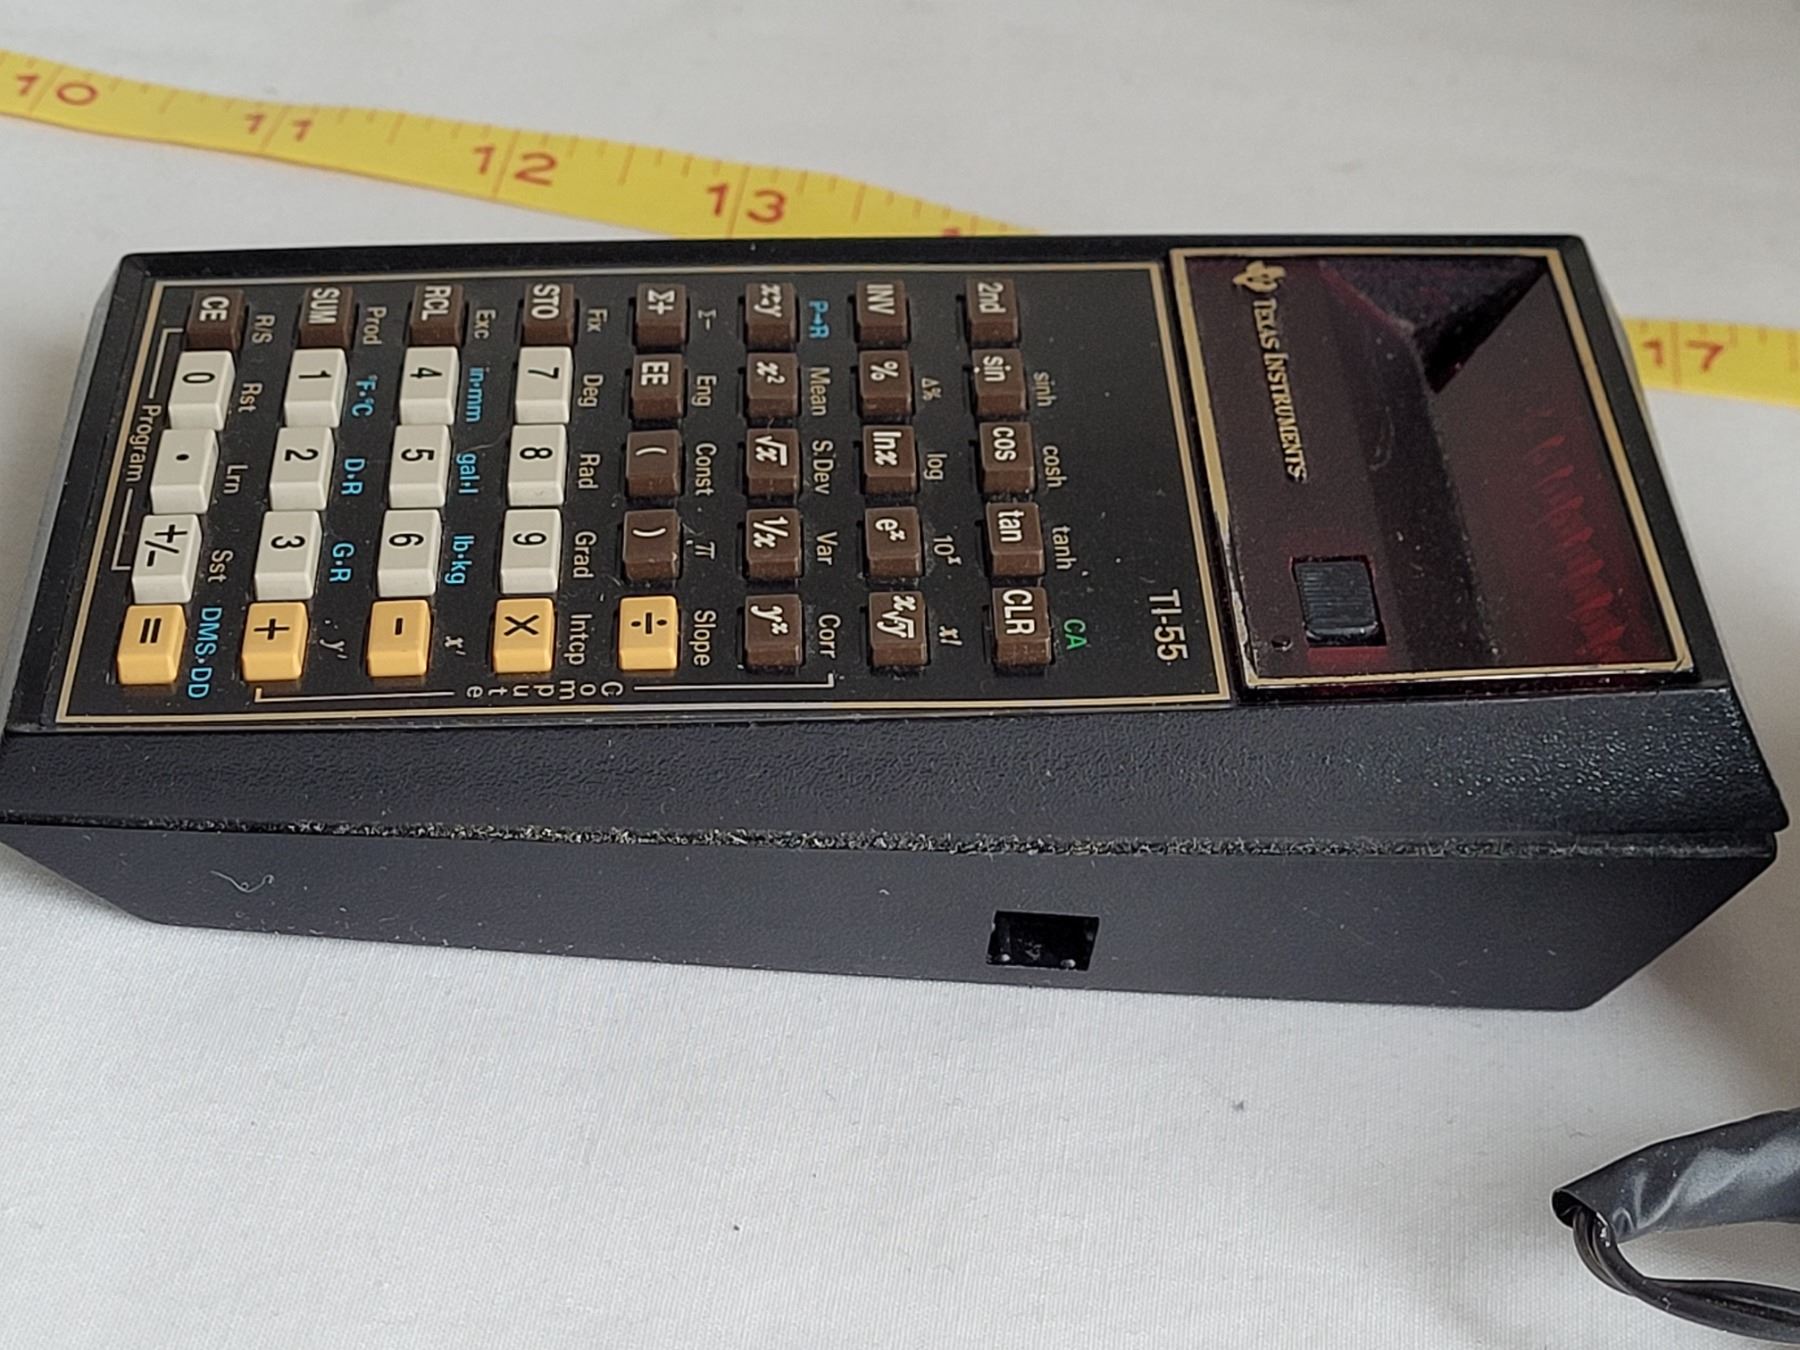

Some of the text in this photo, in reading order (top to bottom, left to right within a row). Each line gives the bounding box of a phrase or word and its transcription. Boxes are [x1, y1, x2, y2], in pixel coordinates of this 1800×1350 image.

[16, 75, 98, 105] 10
[245, 113, 312, 141] 11
[472, 146, 557, 186] 12
[706, 183, 787, 223] 13
[199, 296, 230, 322] CE
[308, 287, 340, 325] SUM
[421, 285, 451, 321] RCL
[531, 284, 561, 319] STO
[866, 284, 896, 315] INV
[978, 282, 1006, 314] 2nd
[252, 314, 275, 343] R/S
[362, 306, 387, 345] Prod
[474, 309, 496, 339] Exc
[587, 308, 608, 332] Fix
[870, 361, 899, 381] %
[983, 356, 1011, 382] sin
[1643, 340, 1724, 372] 17
[182, 372, 215, 384] 0
[298, 370, 332, 379] 1
[410, 367, 442, 379] 4
[528, 367, 560, 379] 7
[641, 361, 669, 386] EE
[1033, 371, 1056, 407] sinh
[238, 383, 262, 413] Rst
[578, 374, 603, 408] Deg
[691, 375, 717, 407] Eng
[809, 367, 830, 416] Mean
[1263, 352, 1309, 483] INSTRUMENTS
[125, 404, 162, 482] Program
[284, 449, 319, 462] 2
[401, 448, 434, 461] 5
[519, 448, 553, 460] 8
[993, 426, 1016, 461] cos
[223, 464, 248, 494] Lrn
[578, 454, 600, 489] Rad
[695, 442, 717, 496] Const
[924, 453, 947, 480] log
[1042, 445, 1067, 489] cosh
[271, 535, 306, 549] 3
[389, 533, 424, 547] 6
[512, 533, 547, 546] 9
[998, 509, 1025, 543] tan
[572, 531, 597, 579] Grad
[816, 531, 838, 565] Var
[1052, 525, 1077, 570] tanh
[207, 549, 234, 583] Sst
[1002, 588, 1036, 635] CLR
[1149, 589, 1188, 661] TI-55
[564, 613, 592, 665] Intcp
[689, 609, 717, 667] Slope
[818, 614, 841, 659] Corr
[1063, 619, 1089, 650] CA
